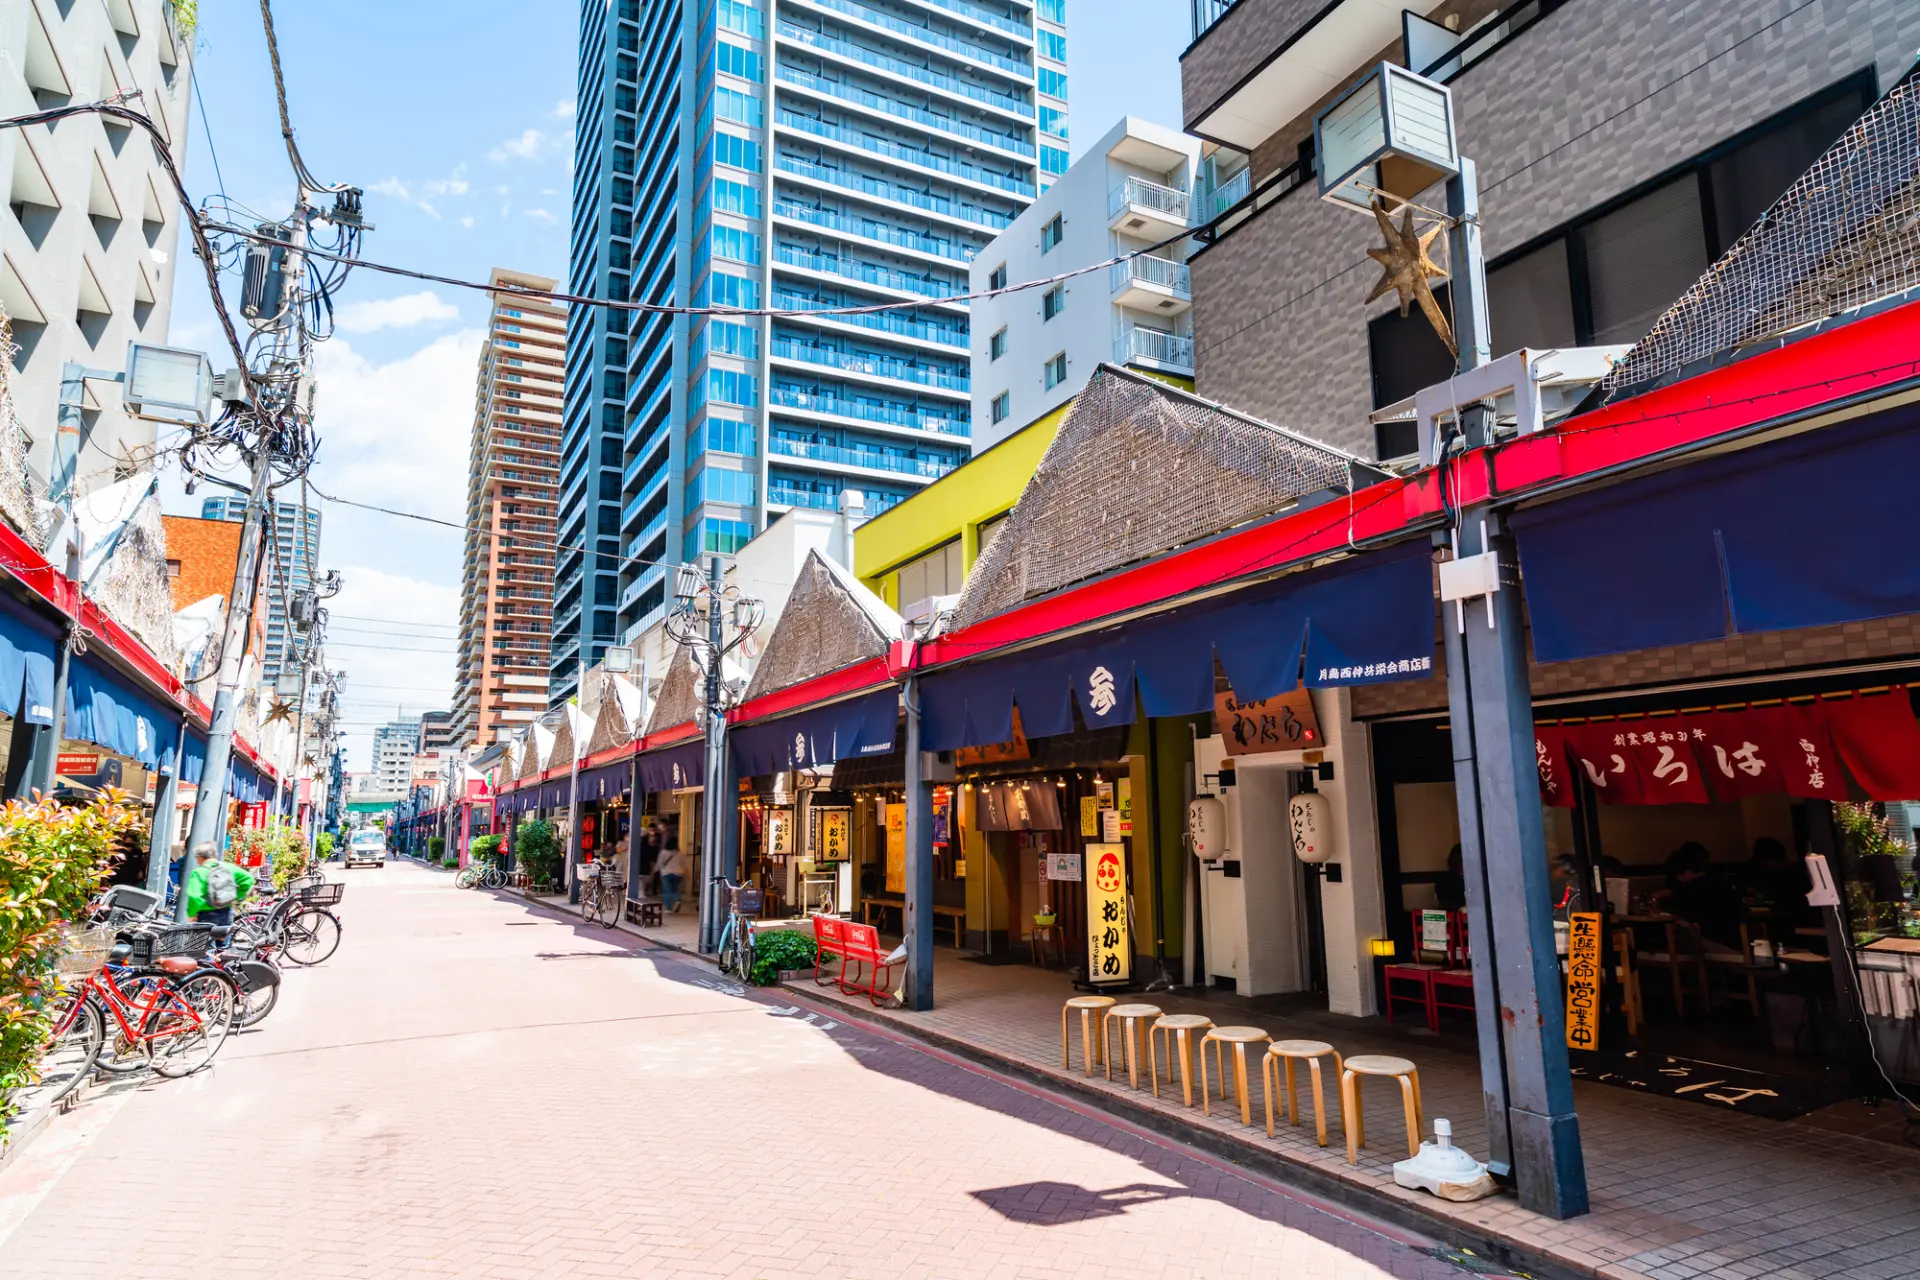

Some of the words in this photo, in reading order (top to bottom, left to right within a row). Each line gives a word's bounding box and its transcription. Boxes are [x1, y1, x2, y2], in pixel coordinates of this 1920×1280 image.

[1089, 666, 1116, 716] 参
[1535, 738, 1557, 795] もんじゃ
[1581, 741, 1766, 787] いろは
[774, 823, 783, 851] おかめ
[828, 827, 839, 858] おかめ
[1102, 899, 1120, 976] おかめ
[1119, 895, 1127, 935] もんじゃ
[1569, 916, 1598, 1047] 一生懸命営業中
